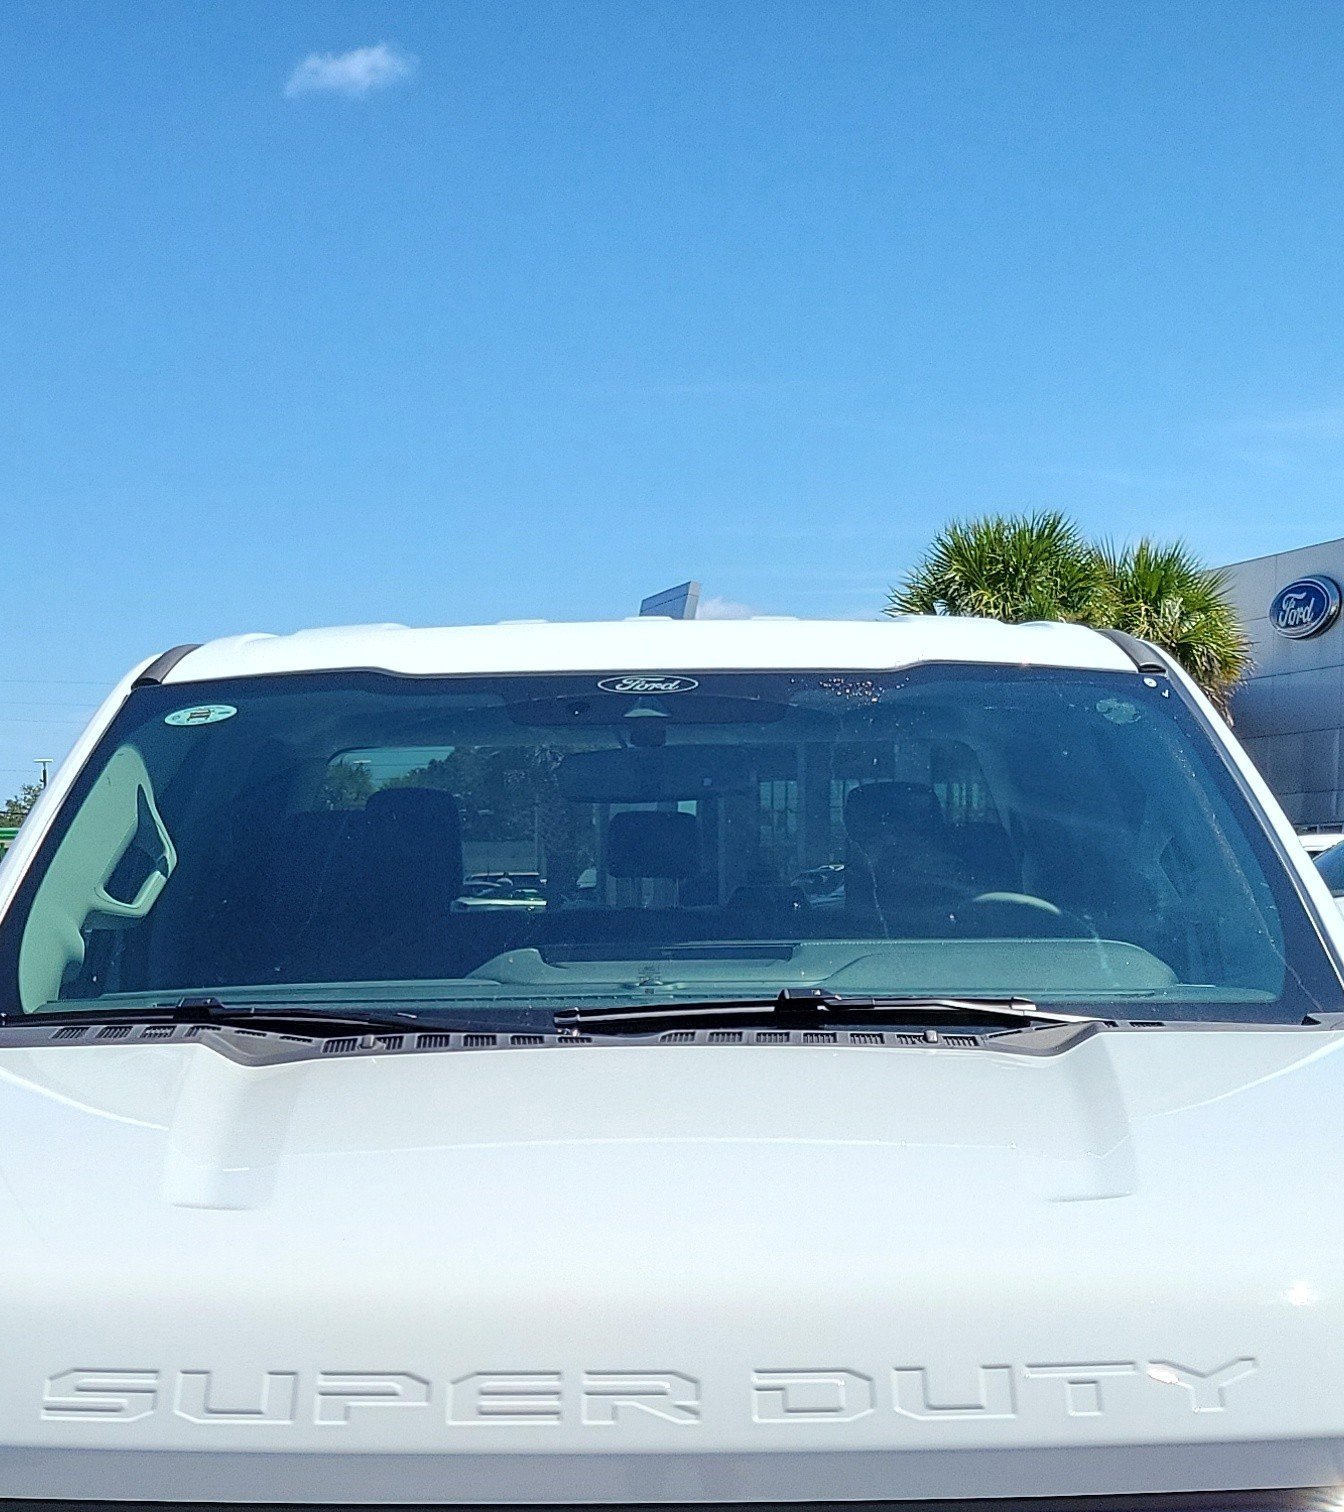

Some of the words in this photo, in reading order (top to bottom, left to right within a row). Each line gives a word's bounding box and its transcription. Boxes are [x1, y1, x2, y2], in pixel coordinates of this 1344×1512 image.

[1278, 592, 1316, 627] Ford
[615, 677, 681, 691] Ford
[40, 1367, 701, 1425] SUPER
[752, 1356, 1257, 1424] DUTY
